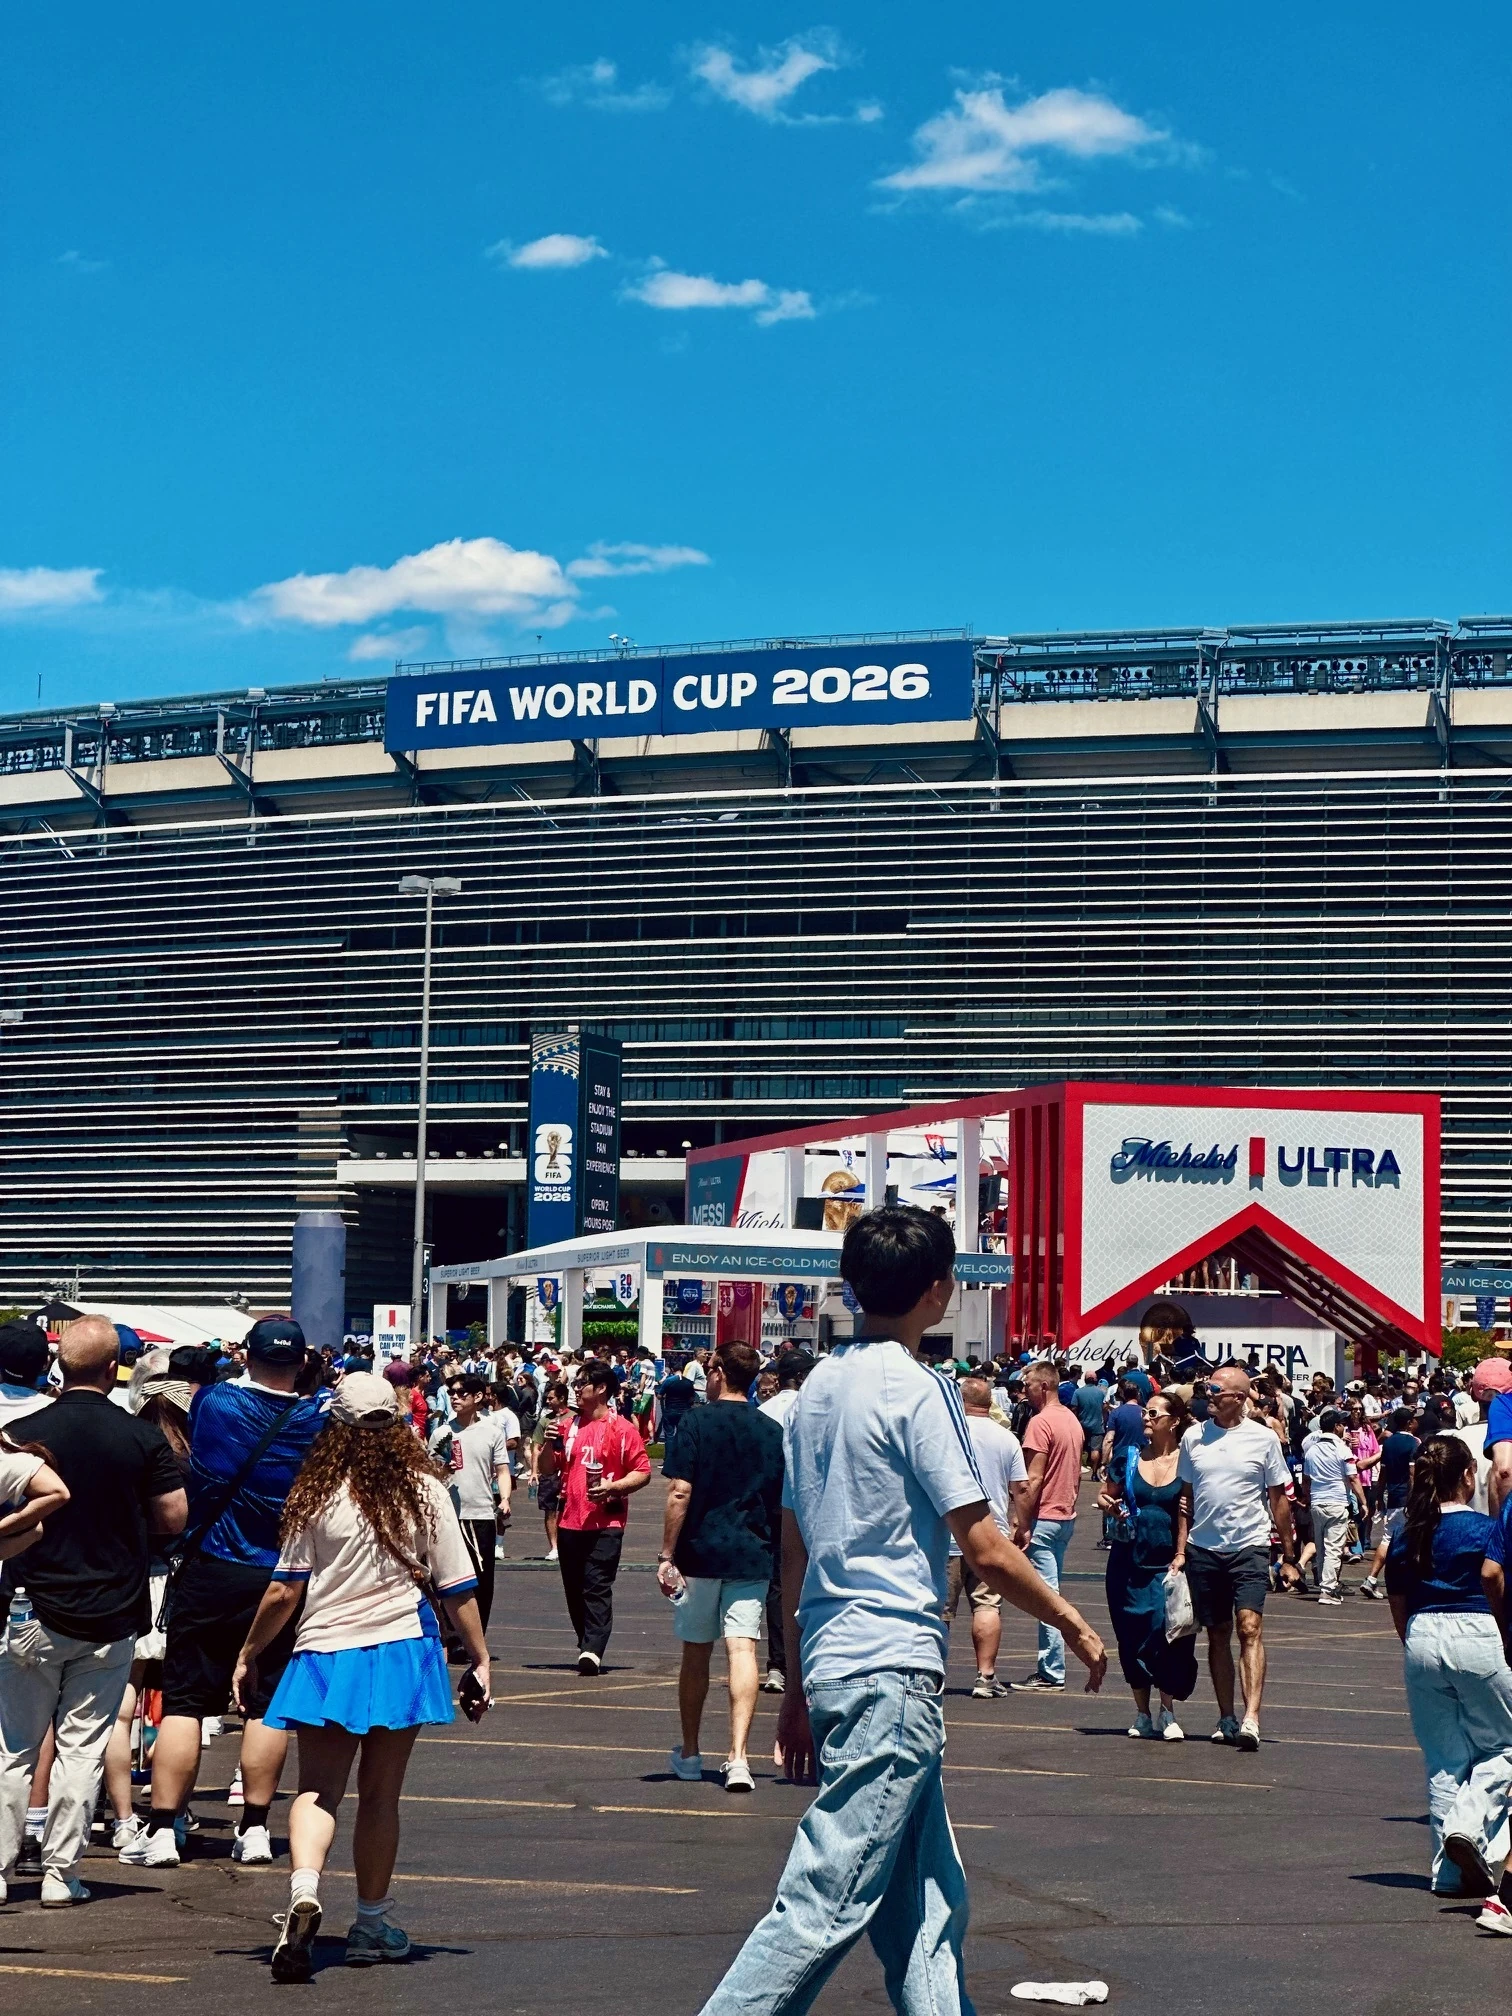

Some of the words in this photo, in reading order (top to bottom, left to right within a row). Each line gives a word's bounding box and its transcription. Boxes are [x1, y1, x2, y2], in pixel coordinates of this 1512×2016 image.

[416, 689, 497, 727] FIFA
[509, 680, 657, 720] WORLD
[673, 672, 757, 711] CUP
[772, 663, 930, 705] 2026
[594, 1084, 606, 1097] STAY
[607, 1086, 611, 1098] &
[588, 1102, 605, 1116] ENJOY
[605, 1105, 616, 1119] THE
[590, 1121, 613, 1137] STADIUM
[596, 1142, 607, 1154] FAN
[1110, 1137, 1239, 1171] Michelob
[1278, 1146, 1402, 1175] ULTRA
[586, 1160, 616, 1175] EXPERIENCE
[534, 1185, 557, 1193] WORLD
[558, 1185, 572, 1193] CUP
[533, 1192, 571, 1202] 2026
[590, 1198, 605, 1211] OPEN
[605, 1200, 610, 1212] 2
[692, 1202, 726, 1226] MESSI
[584, 1217, 602, 1229] HOURS
[602, 1219, 615, 1231] POST
[424, 1250, 430, 1266] F
[577, 1251, 600, 1263] SUPERIOR
[601, 1250, 616, 1261] LIGHT
[617, 1248, 630, 1259] BEER
[672, 1253, 719, 1265] ENJOY
[721, 1256, 742, 1266] AN
[745, 1256, 811, 1268] ICE-COLD
[422, 1278, 429, 1294] 3
[620, 1273, 632, 1287] 20
[1446, 1277, 1466, 1287] AN
[620, 1286, 632, 1299] 26
[378, 1333, 394, 1342] THINK
[395, 1333, 406, 1342] YOU
[380, 1341, 391, 1350] CAN
